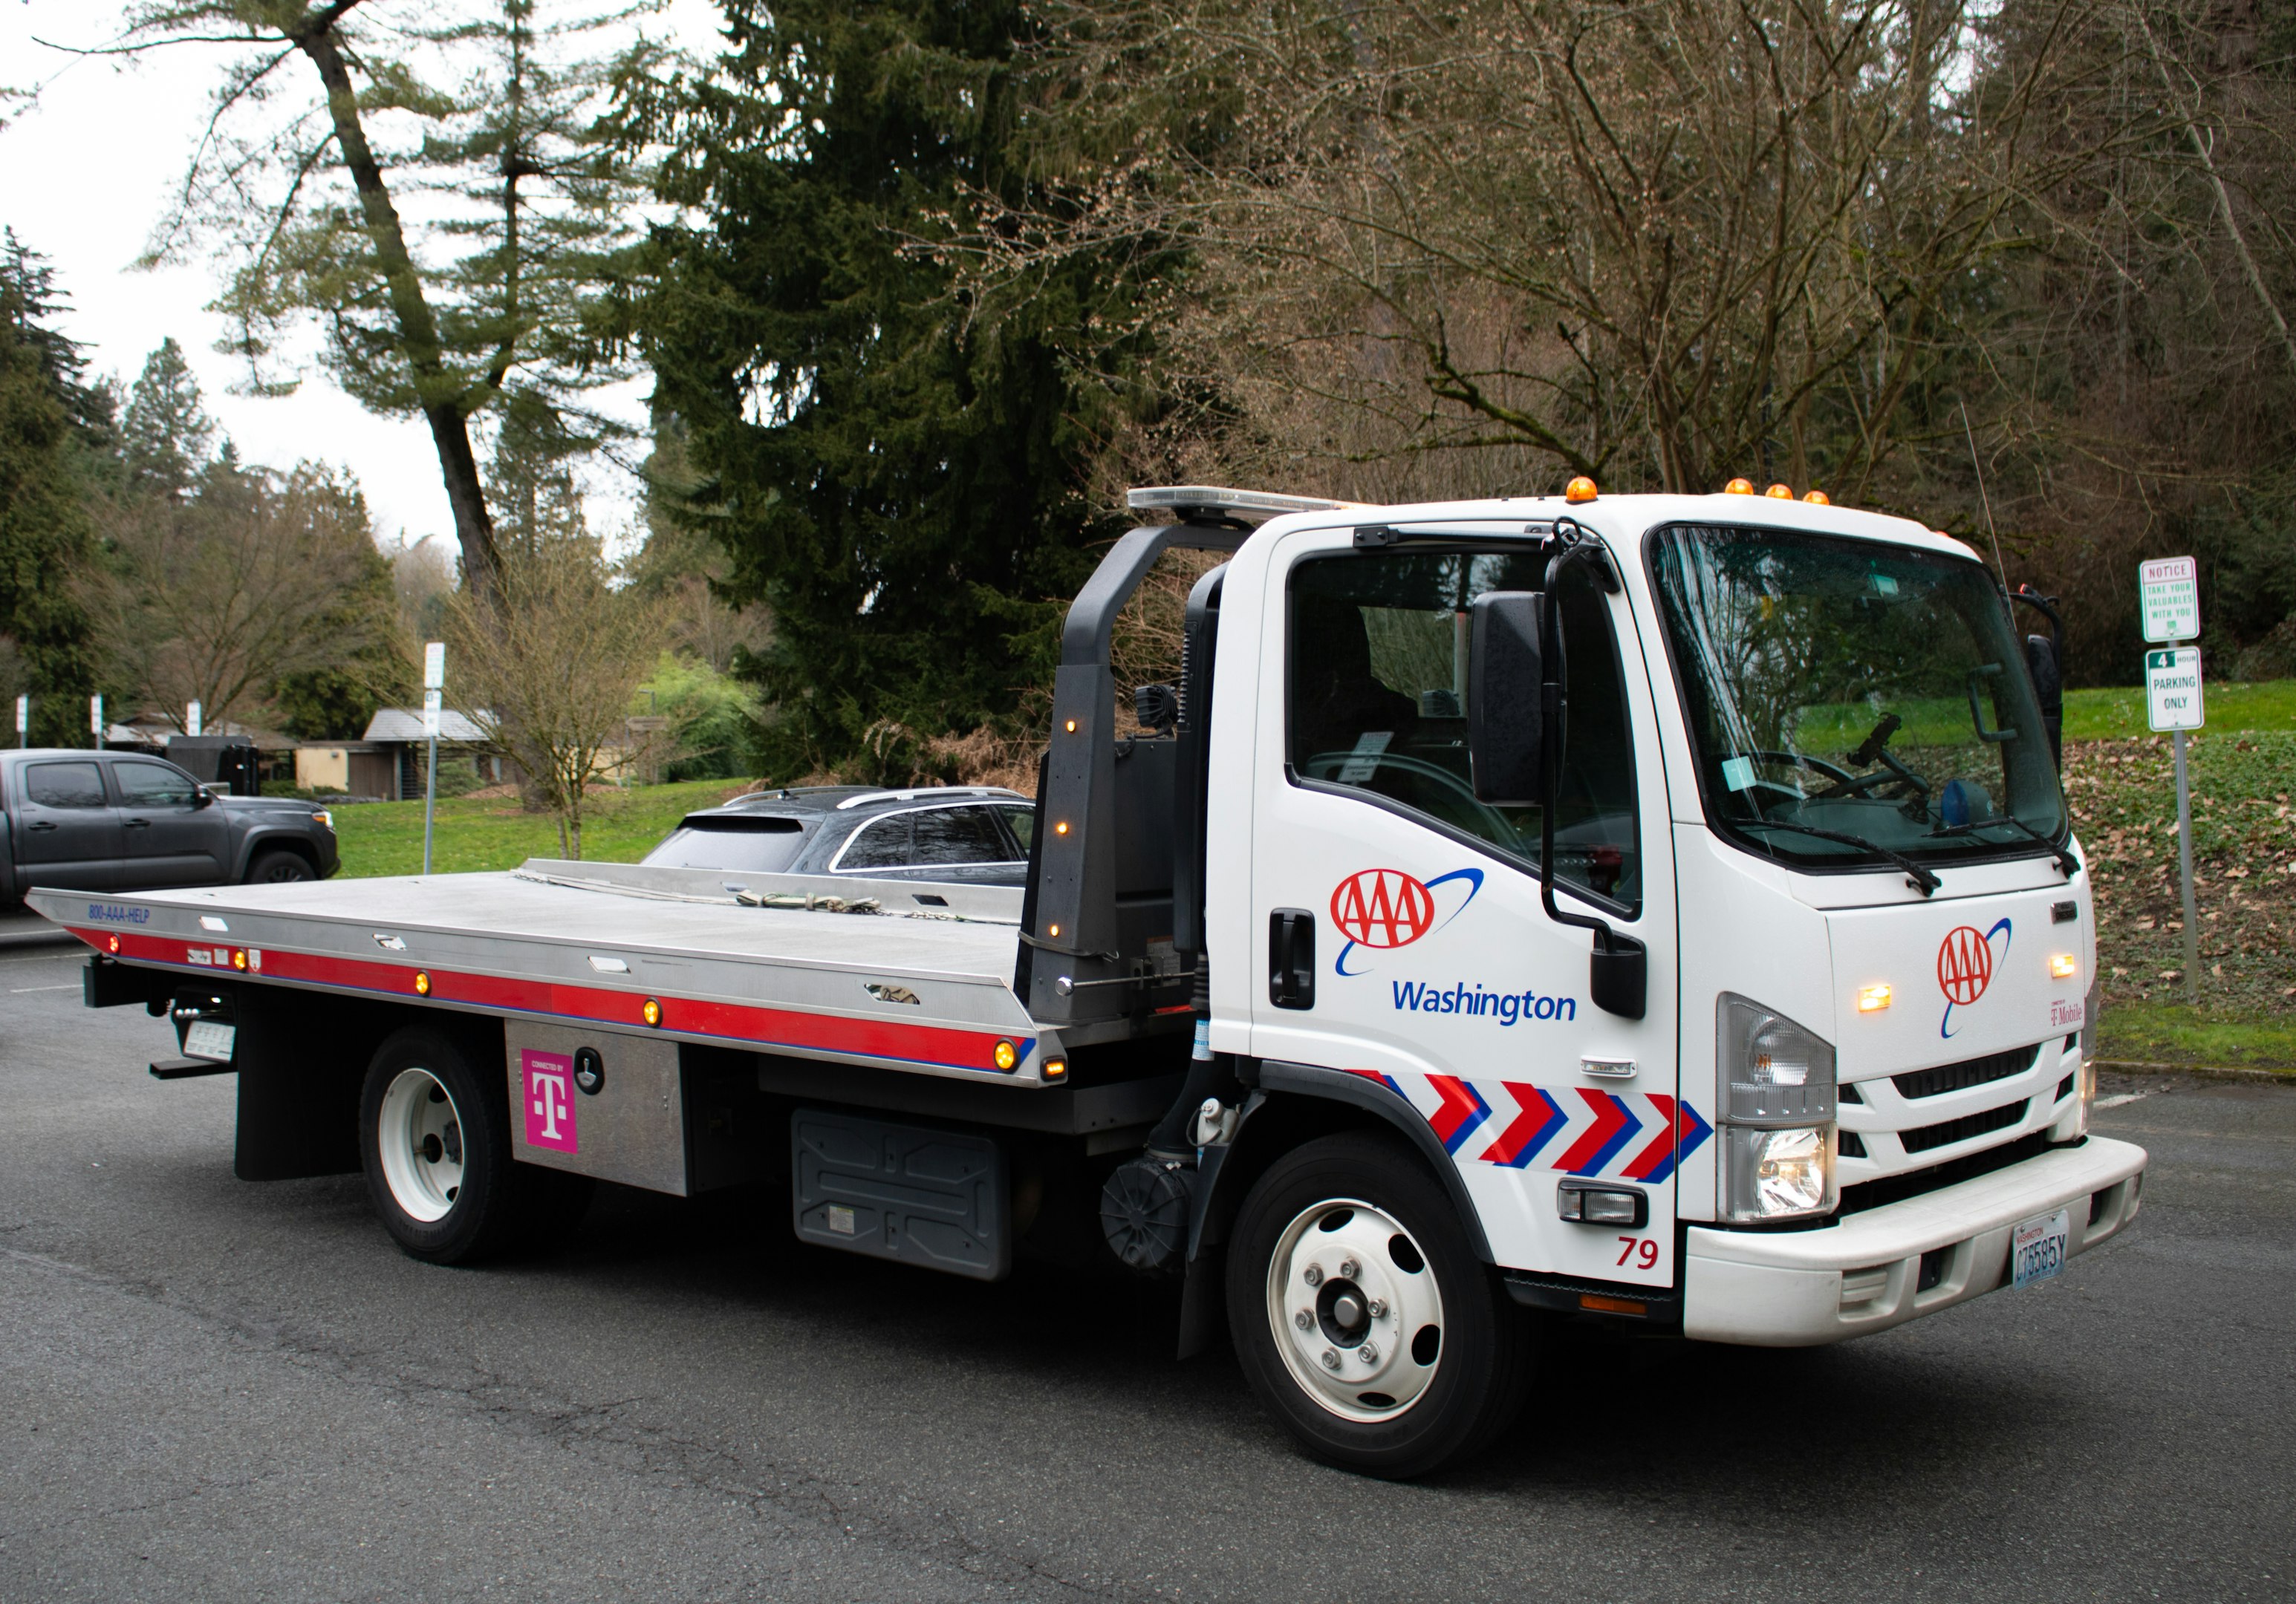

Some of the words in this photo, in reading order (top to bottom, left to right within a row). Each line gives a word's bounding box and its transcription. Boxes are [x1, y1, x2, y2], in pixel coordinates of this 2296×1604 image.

[2149, 564, 2186, 578] NOTICE
[2147, 584, 2166, 594] TAKE
[2170, 582, 2191, 593] YOUR
[2148, 594, 2193, 607] VALUABLES
[2152, 609, 2172, 619] WITH
[2176, 607, 2191, 617] YOU
[2158, 653, 2168, 668] 4
[2153, 676, 2196, 691] PARKING
[2164, 696, 2188, 710] ONLY
[88, 904, 150, 924] 800-AAA-HELP
[1339, 870, 1428, 948] AAA
[1940, 927, 1989, 1004] AAA
[1392, 980, 1576, 1026] Washington
[531, 1060, 557, 1072] CONNECTED
[557, 1064, 564, 1072] BY
[2017, 1227, 2043, 1245] WASHINGTON
[1616, 1236, 1659, 1270] 79
[2017, 1233, 2066, 1280] C75585Y
